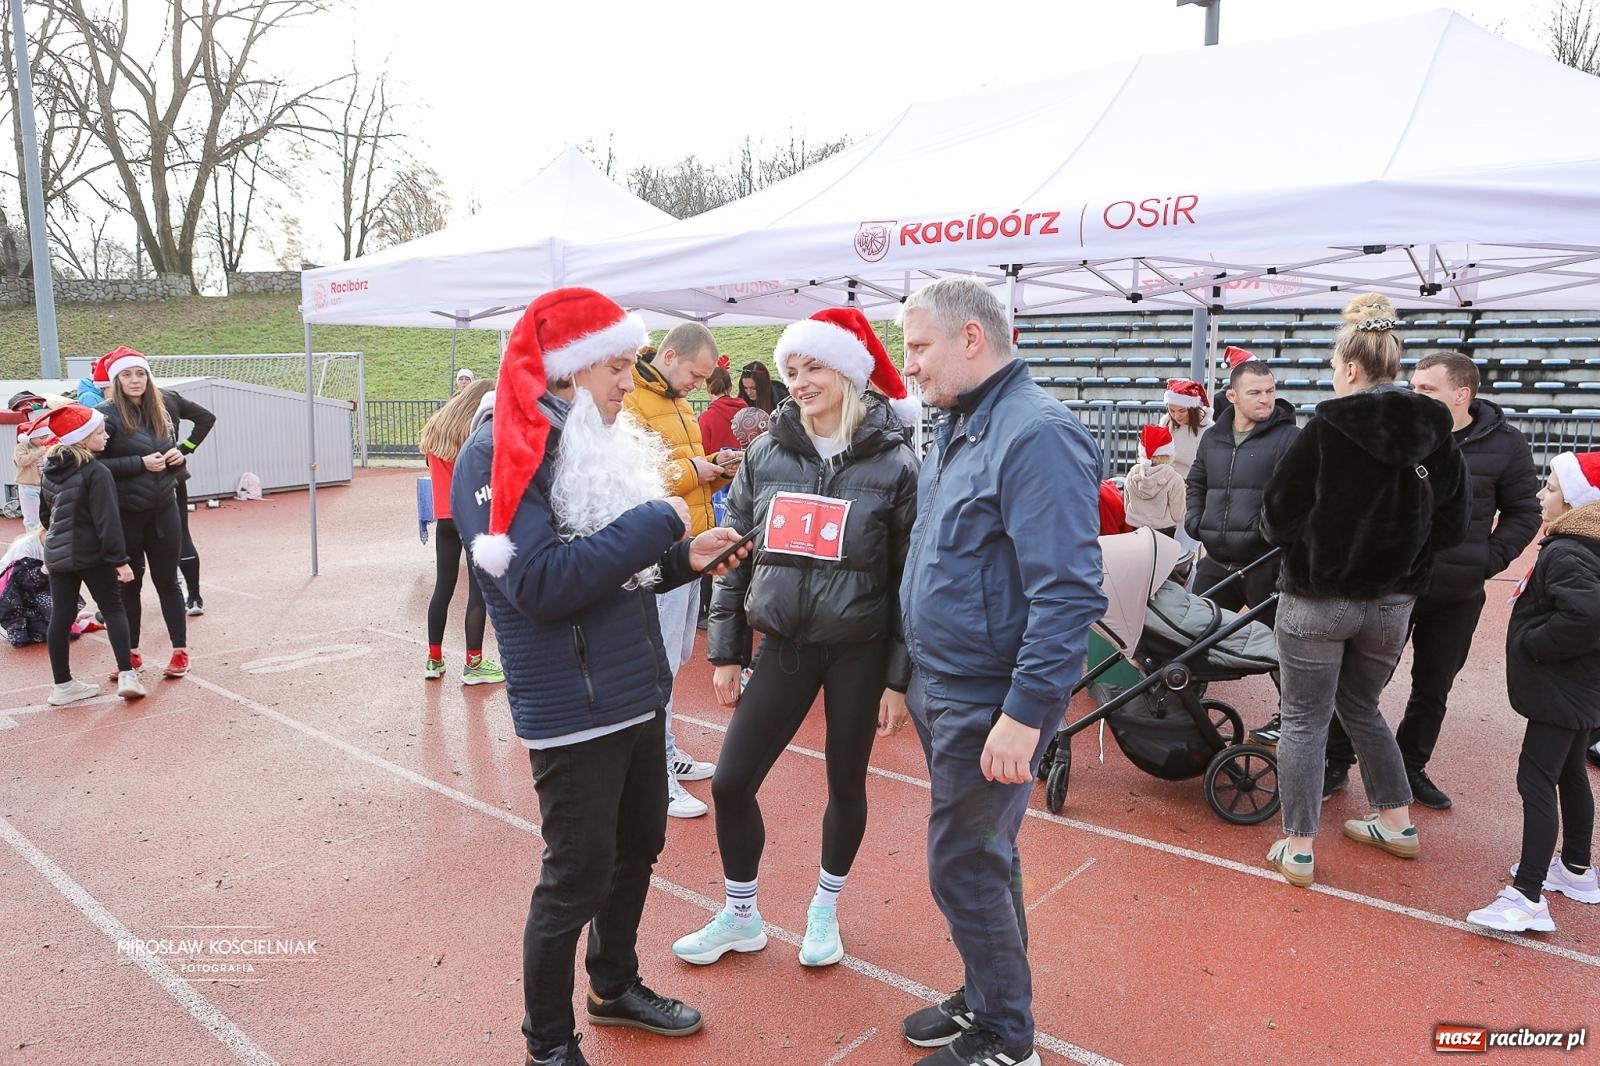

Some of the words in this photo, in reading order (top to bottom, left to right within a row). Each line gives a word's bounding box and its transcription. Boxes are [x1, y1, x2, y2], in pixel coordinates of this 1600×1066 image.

[900, 208, 1060, 246] Racibórz
[1104, 195, 1199, 230] OSiR
[330, 279, 369, 293] Racibórz
[801, 512, 812, 535] 1
